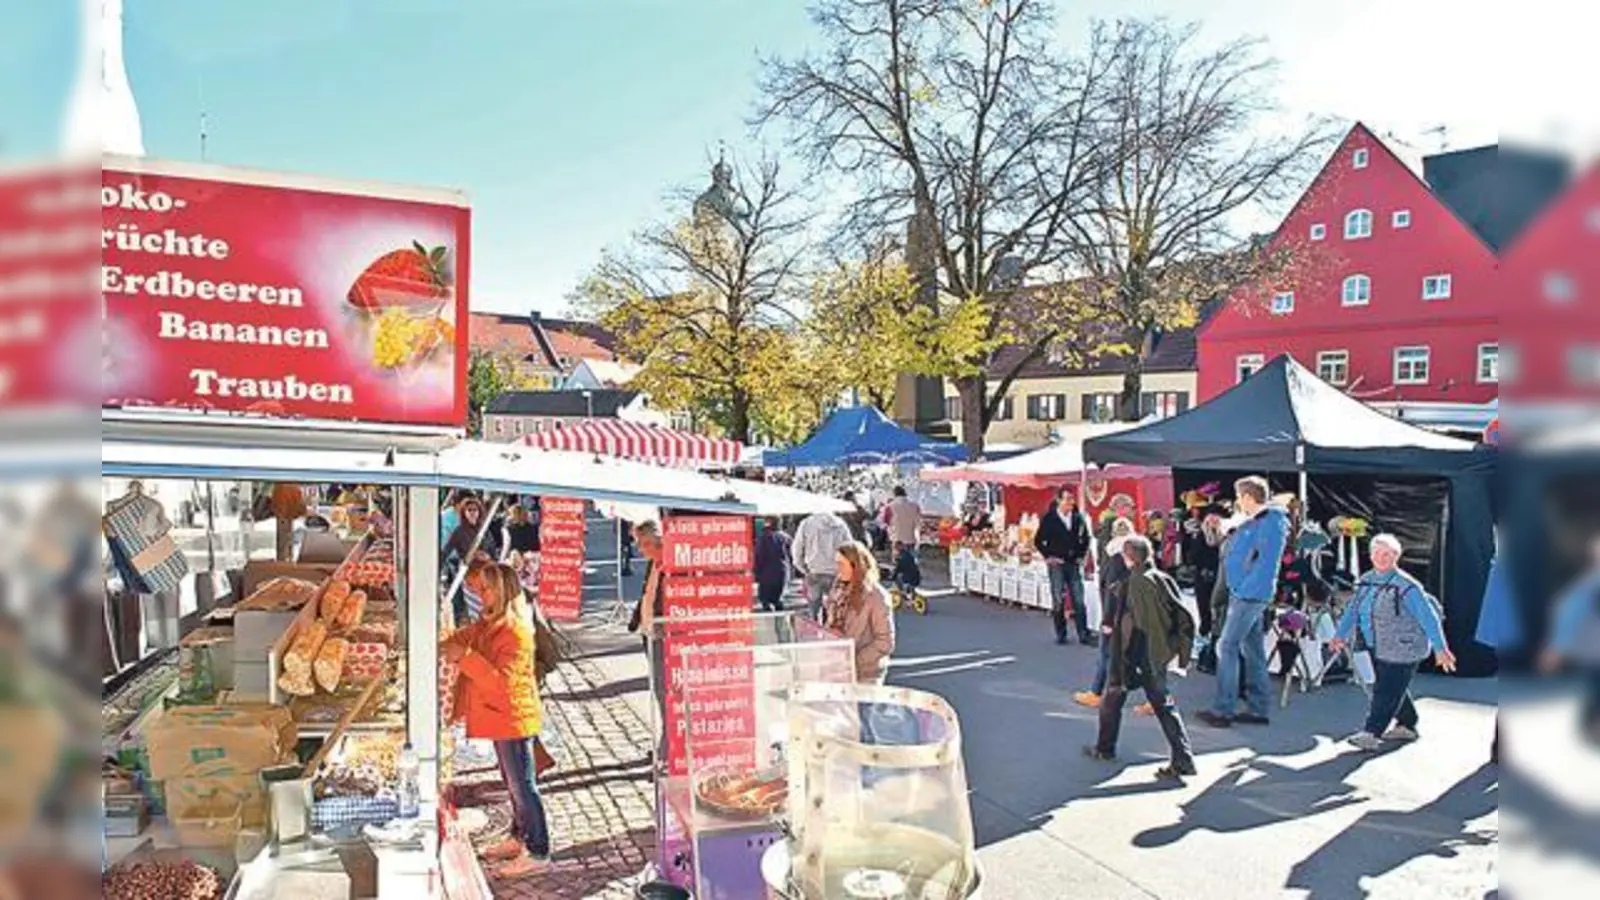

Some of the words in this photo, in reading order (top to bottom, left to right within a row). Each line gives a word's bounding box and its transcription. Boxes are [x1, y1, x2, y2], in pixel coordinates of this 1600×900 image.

[102, 265, 304, 307] Erdbeeren
[158, 311, 329, 348] Bananen
[189, 368, 354, 404] Trauben
[674, 543, 748, 566] Mandeln
